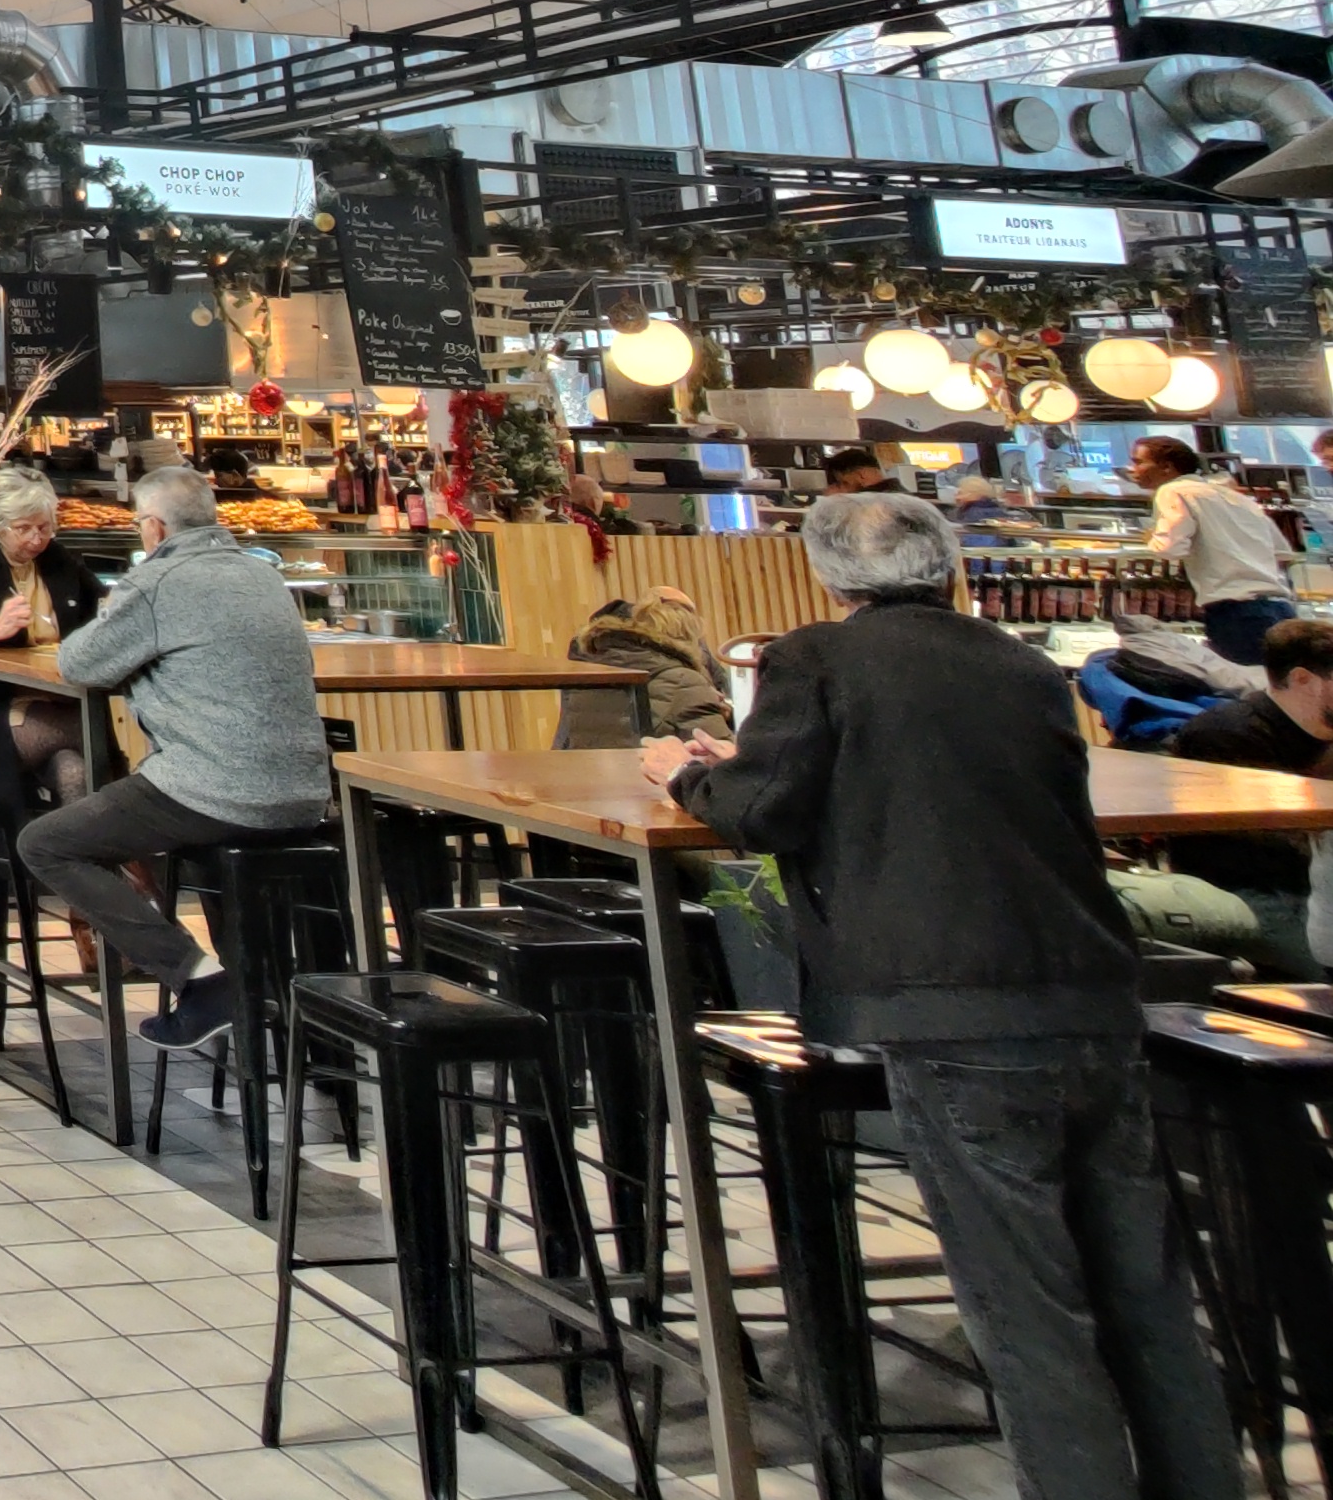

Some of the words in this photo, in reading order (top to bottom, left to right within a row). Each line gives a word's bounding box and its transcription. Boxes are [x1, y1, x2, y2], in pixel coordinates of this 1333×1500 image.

[159, 166, 200, 180] CHOP
[205, 169, 245, 183] CHOP
[165, 181, 241, 198] POKÉ-WOK
[1005, 217, 1054, 230] ADONYS
[976, 233, 1031, 246] TRAITEUR
